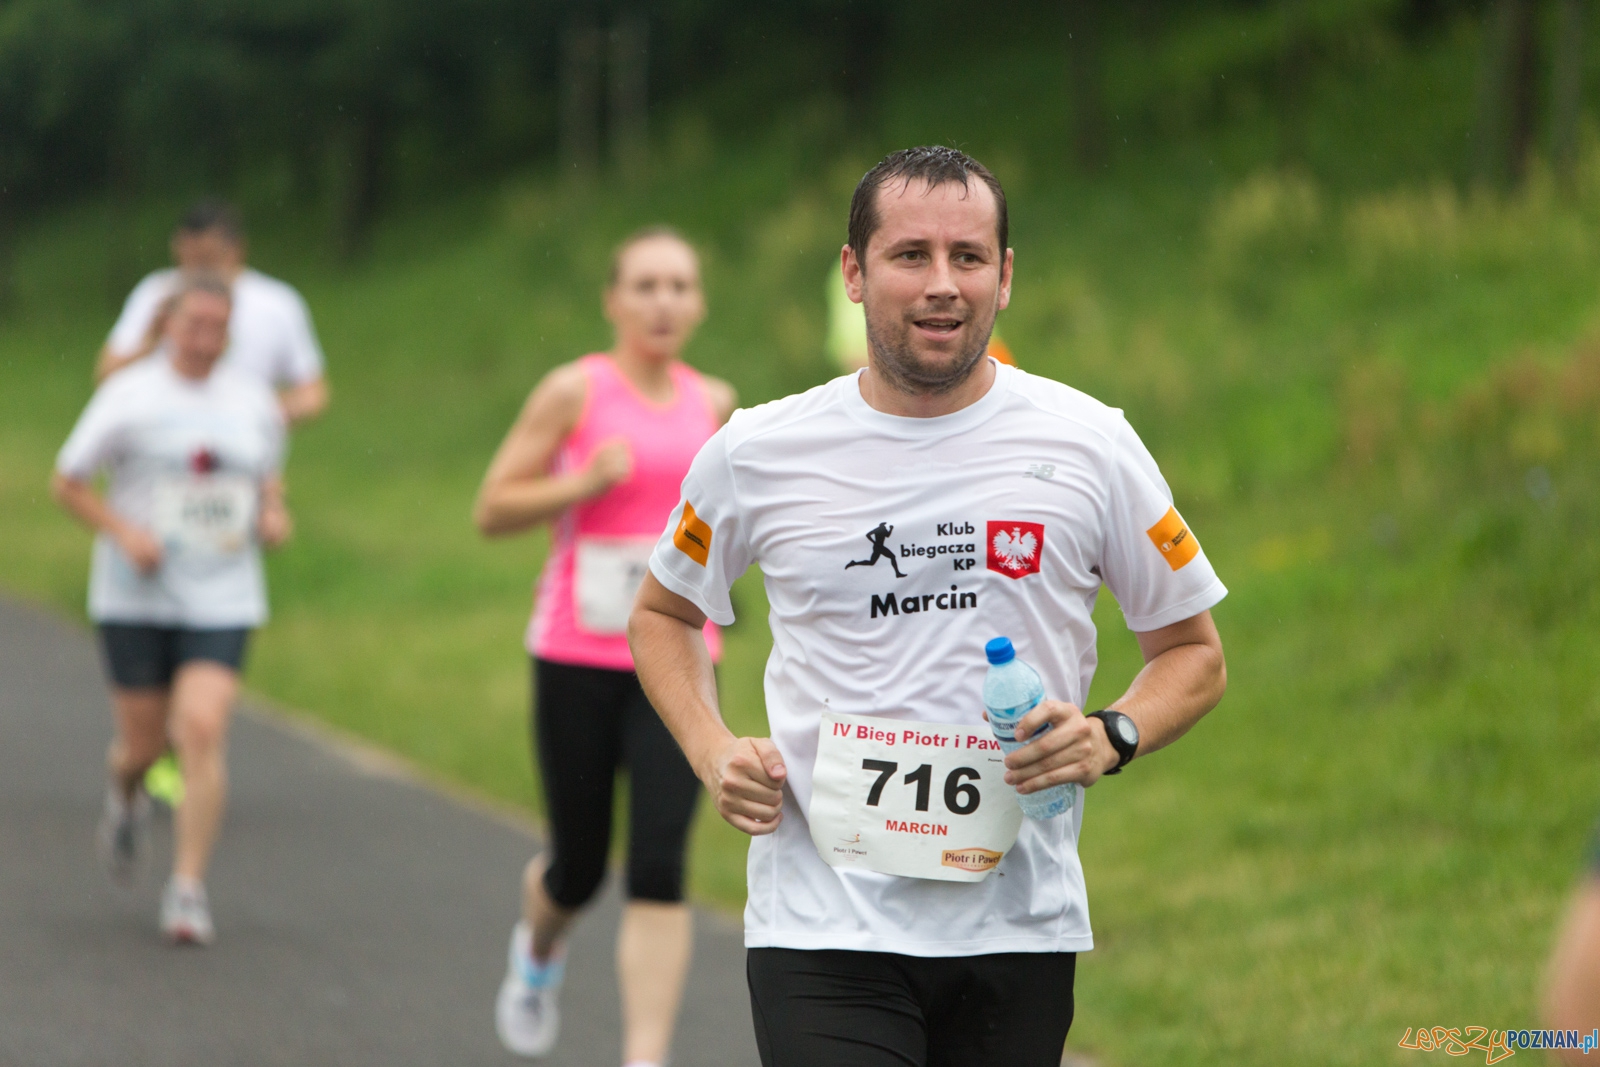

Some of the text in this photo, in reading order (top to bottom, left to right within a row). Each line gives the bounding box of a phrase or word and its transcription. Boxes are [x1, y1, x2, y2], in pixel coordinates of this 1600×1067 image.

[937, 521, 975, 536] Klub
[900, 543, 975, 559] biegacza
[953, 558, 976, 571] KP
[870, 584, 977, 619] Marcin
[833, 722, 1001, 751] IV Bieg Piotr i Paw
[861, 758, 982, 816] 716
[885, 819, 948, 836] MARCIN
[944, 852, 970, 863] Piotr
[972, 854, 976, 863] i
